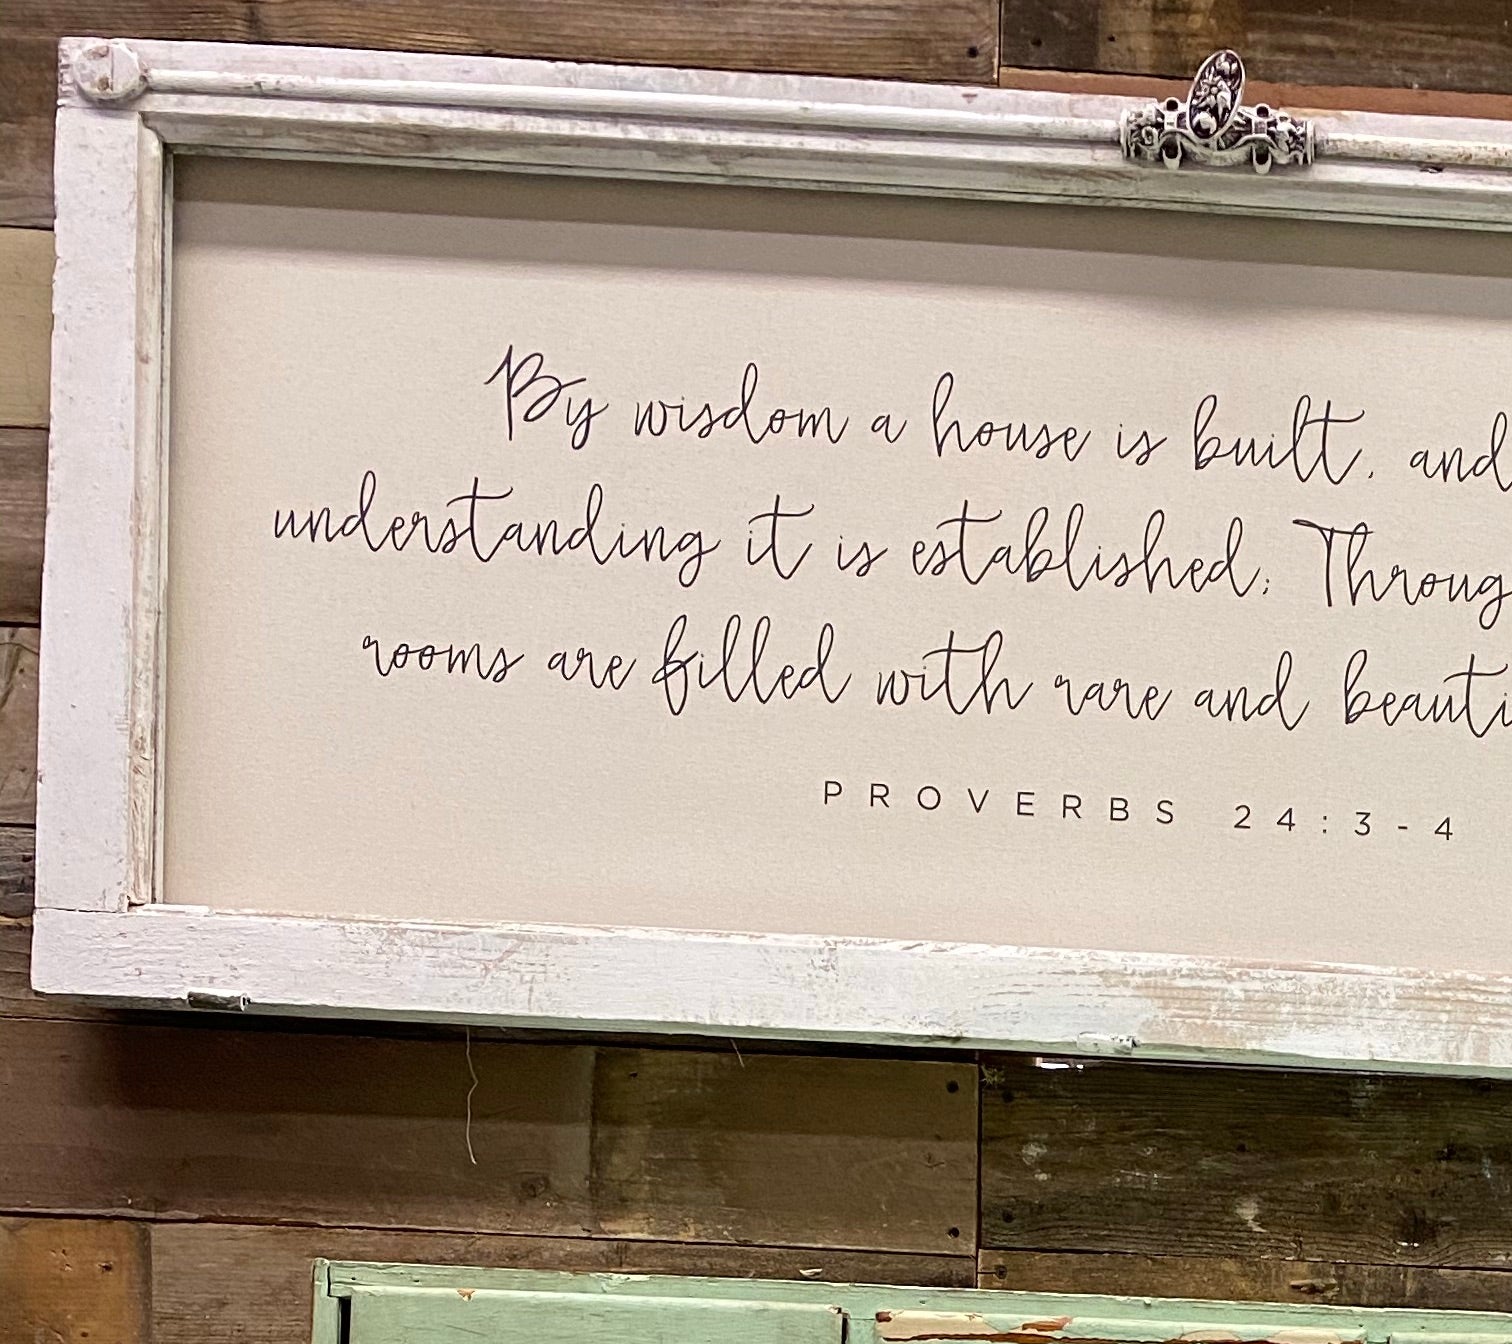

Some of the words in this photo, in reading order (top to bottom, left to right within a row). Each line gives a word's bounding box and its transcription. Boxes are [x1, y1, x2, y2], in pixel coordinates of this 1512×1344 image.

[484, 345, 609, 451] By
[635, 363, 849, 445] wisdom
[871, 414, 907, 444] a
[933, 372, 1092, 462] house
[1115, 423, 1168, 467] is
[274, 470, 722, 588] understanding
[746, 494, 815, 580] it
[837, 536, 889, 577] is
[362, 636, 525, 684] rooms
[547, 648, 637, 691] are
[651, 614, 853, 716] filled
[876, 630, 1034, 715] with
[1054, 674, 1173, 721] rare
[1194, 651, 1311, 731] and
[823, 780, 1174, 825] PROVERBS
[1233, 804, 1454, 841] 24:3-4
